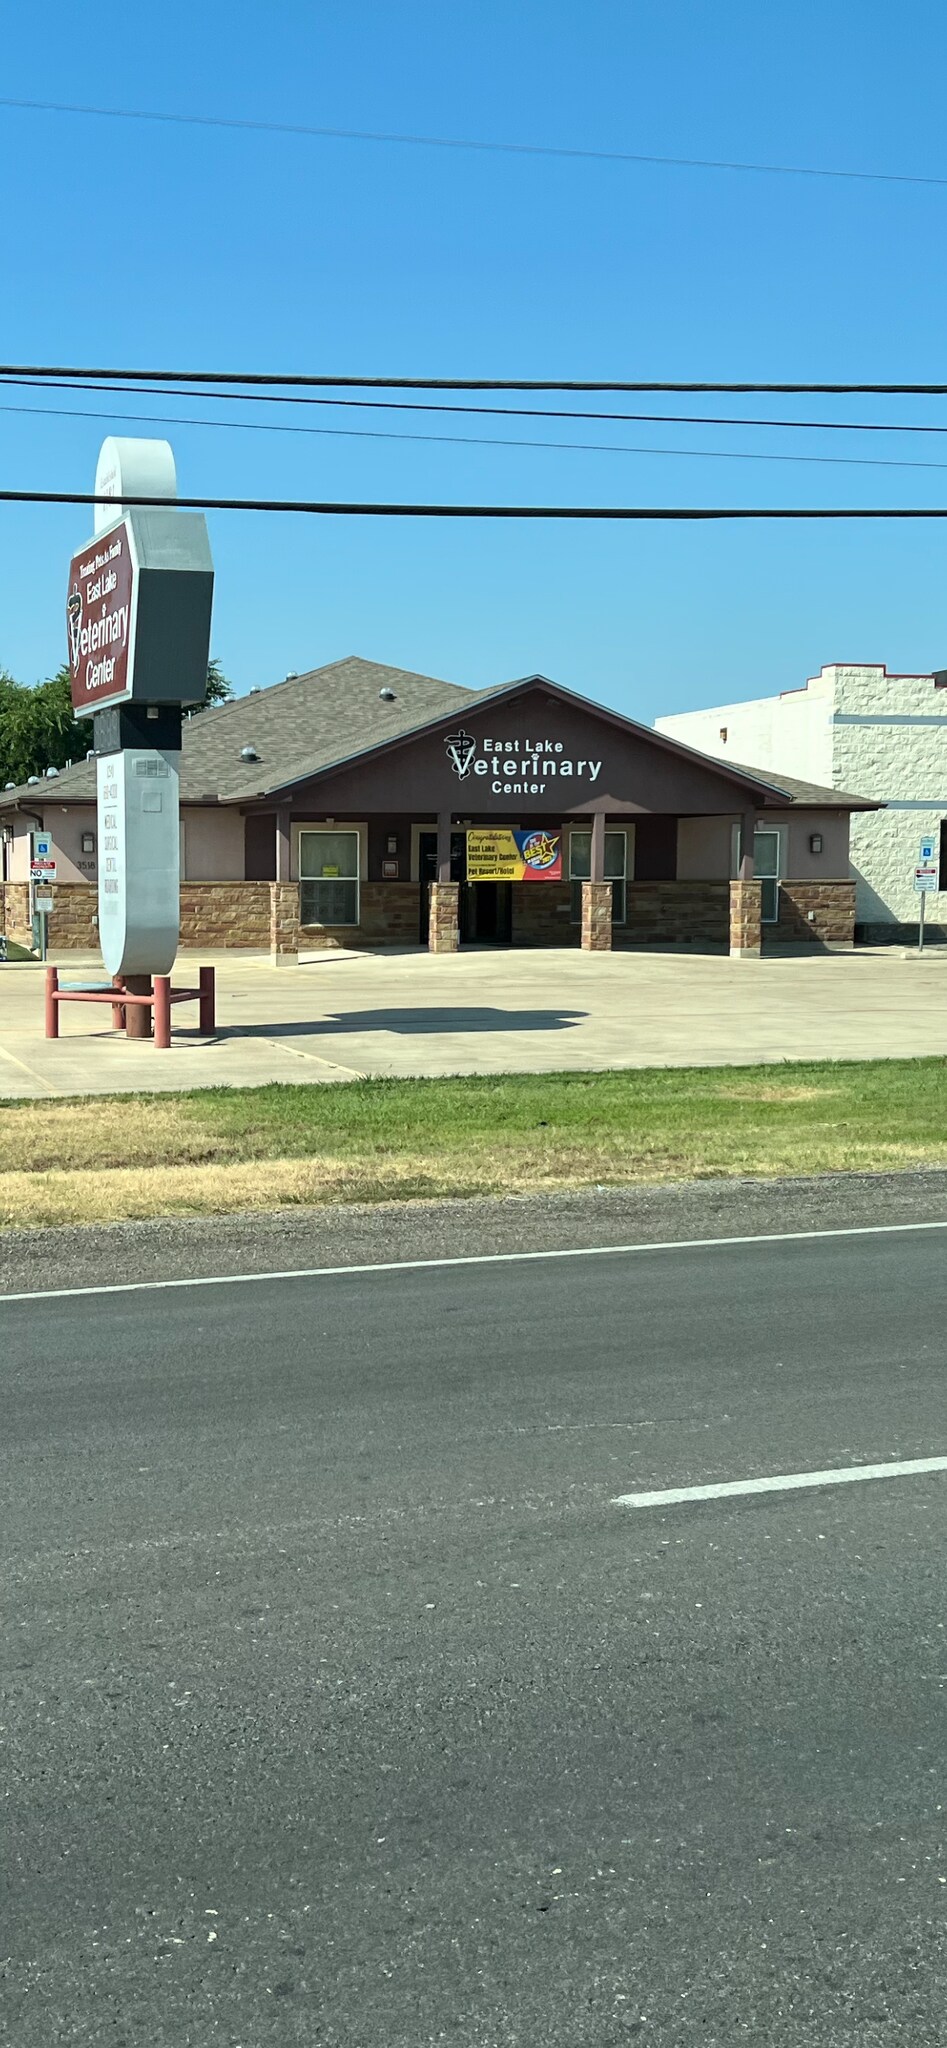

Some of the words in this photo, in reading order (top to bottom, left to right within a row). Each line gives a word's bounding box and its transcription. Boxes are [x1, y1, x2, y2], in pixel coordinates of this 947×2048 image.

[86, 579, 101, 605] East
[101, 569, 118, 600] Lake
[68, 604, 129, 668] Veterinary
[85, 654, 116, 691] Center
[483, 739, 520, 752] East
[525, 739, 564, 753] Lake
[450, 745, 602, 782] Veterinary
[491, 780, 546, 794] Center
[499, 853, 518, 861] Center
[523, 842, 547, 860] BEST
[30, 869, 42, 877] NO
[77, 861, 96, 870] 3518
